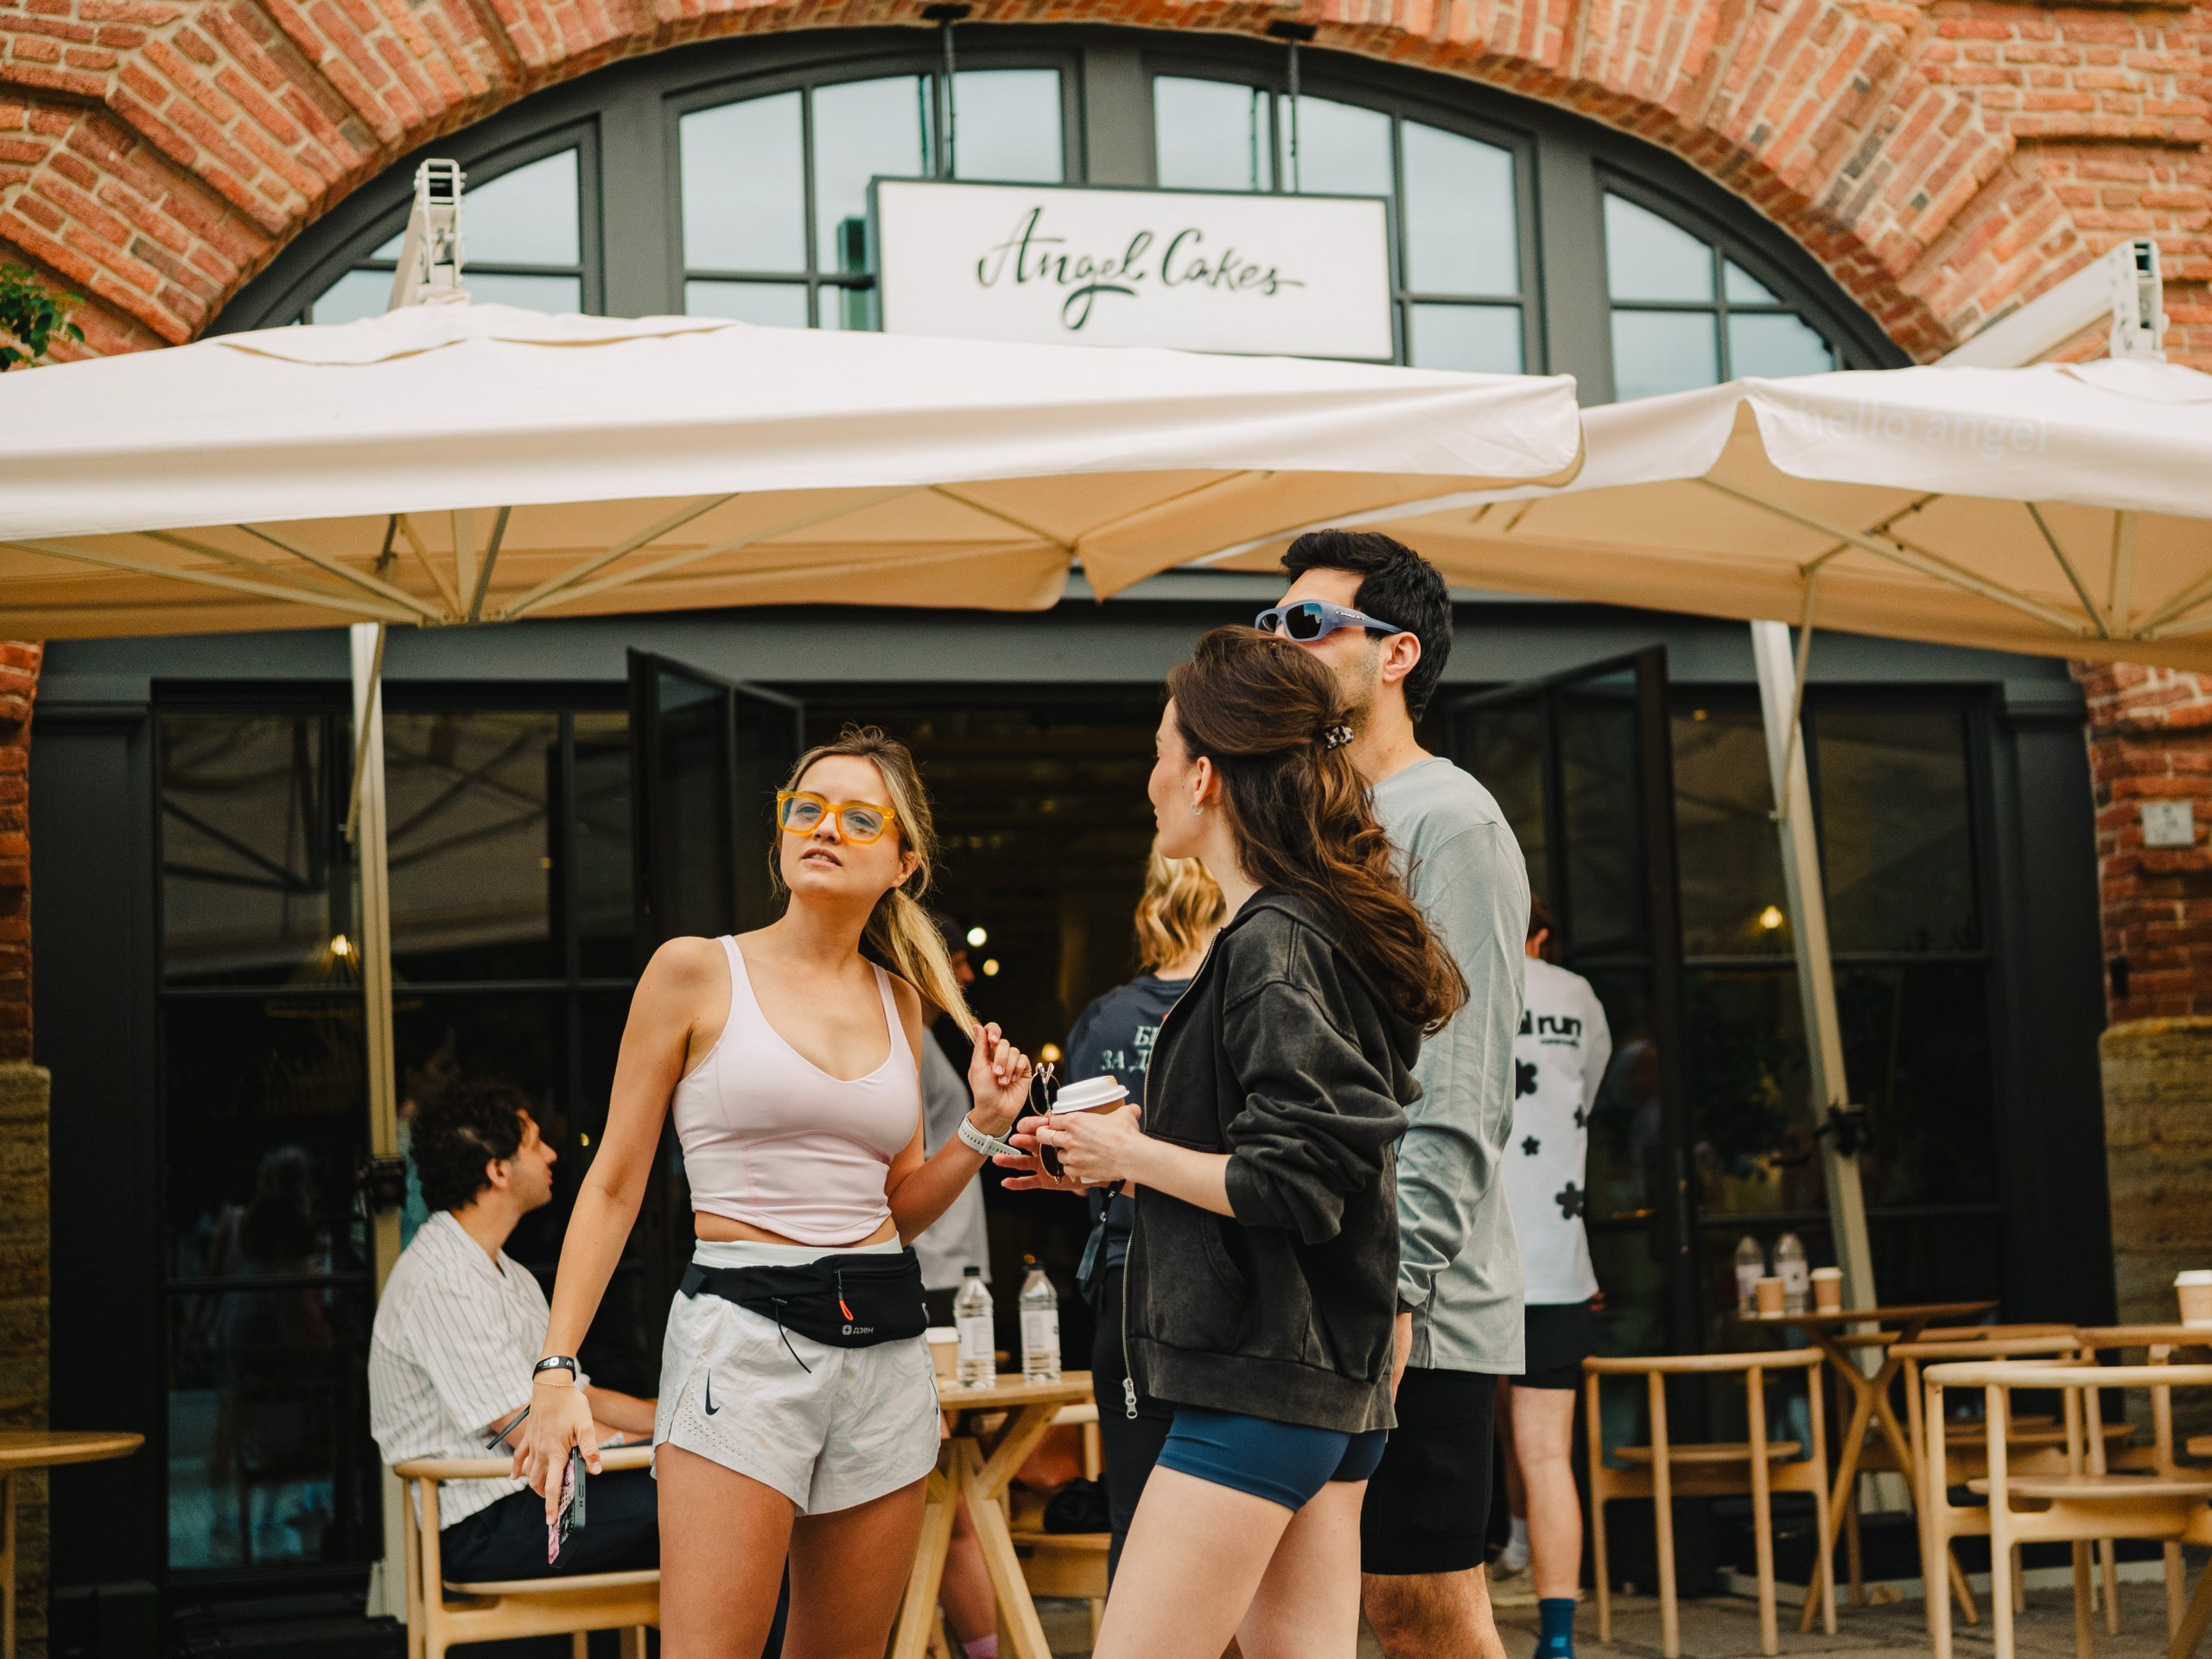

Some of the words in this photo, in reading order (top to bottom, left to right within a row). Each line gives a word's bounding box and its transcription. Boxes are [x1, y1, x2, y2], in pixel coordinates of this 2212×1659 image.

[976, 206, 1154, 331] Angel
[1161, 227, 1306, 296] Cakes
[1797, 394, 1910, 443] hello
[1924, 414, 2047, 462] angel
[1537, 1015, 1581, 1037] run
[1099, 1049, 1125, 1071] ЗА
